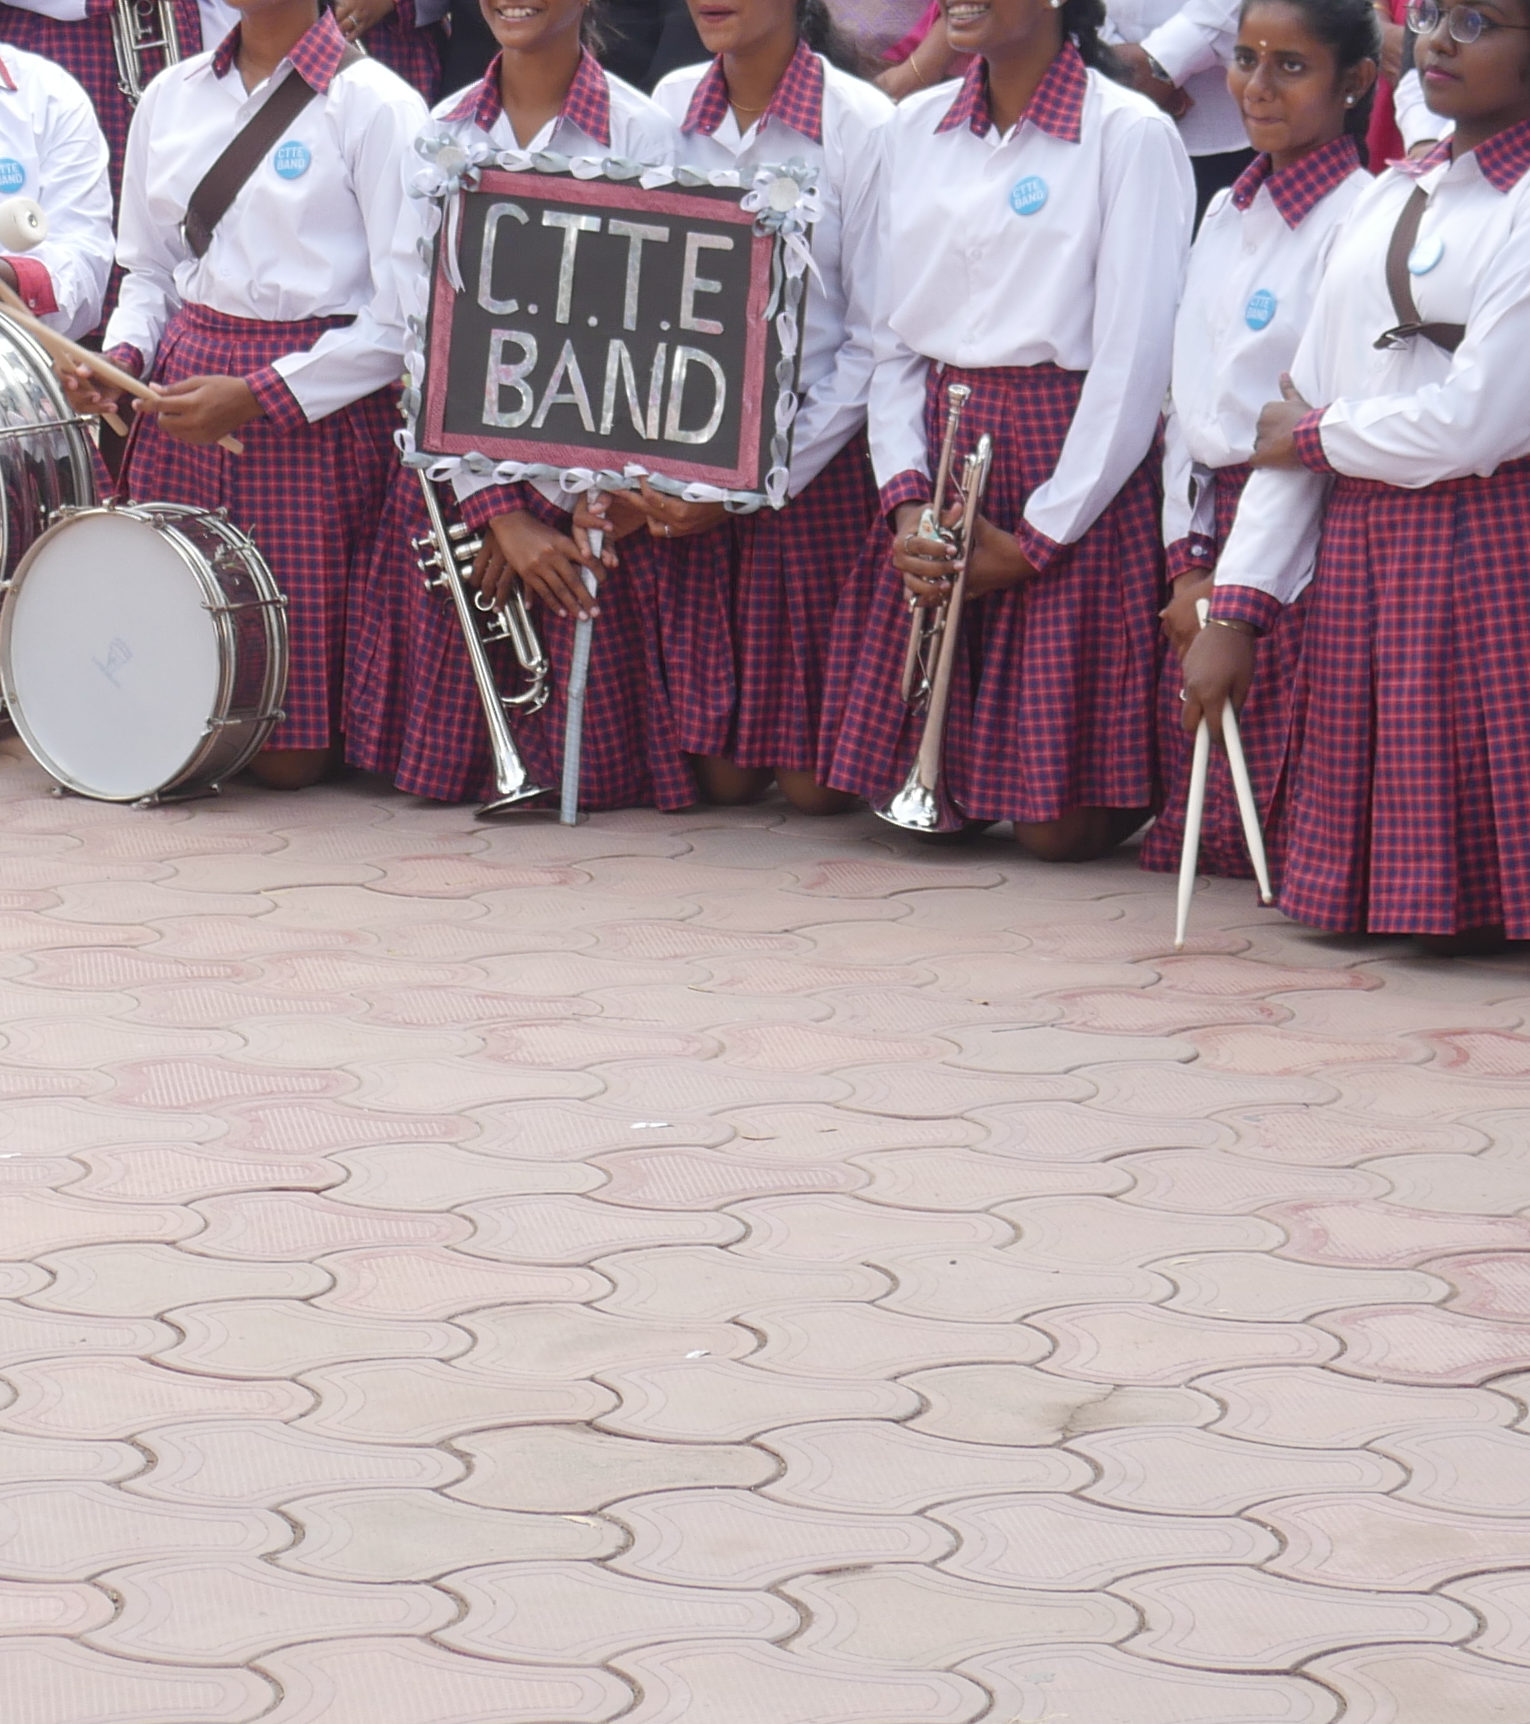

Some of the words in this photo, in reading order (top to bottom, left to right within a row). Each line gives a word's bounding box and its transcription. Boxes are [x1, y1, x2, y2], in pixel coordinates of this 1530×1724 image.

[278, 146, 304, 159] CTTE
[276, 157, 306, 169] BAND
[1012, 179, 1038, 197] CTTE
[1014, 188, 1044, 209] BAND
[476, 202, 735, 336] C.T.T.E
[481, 328, 728, 445] BAND
